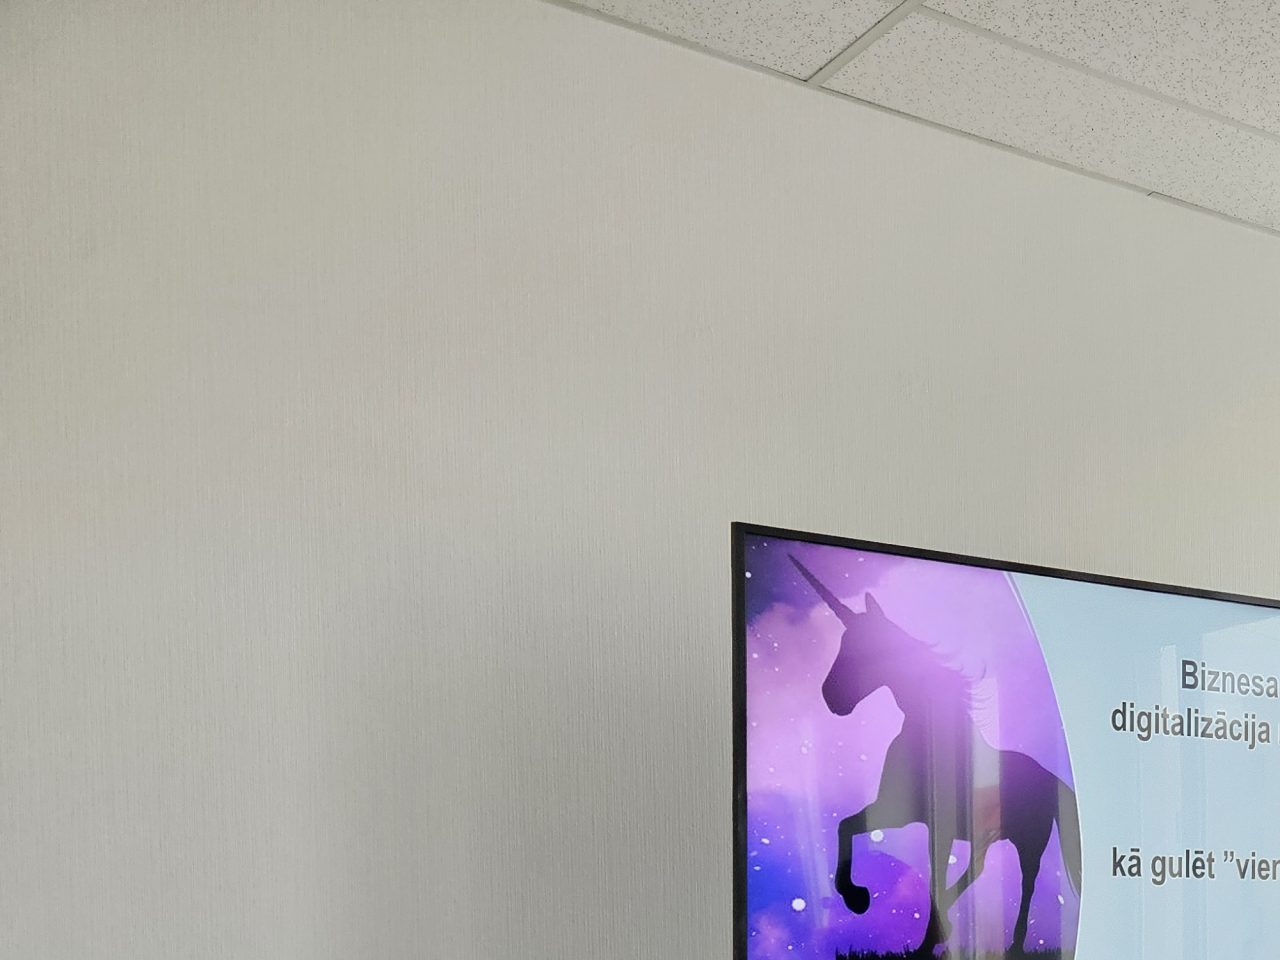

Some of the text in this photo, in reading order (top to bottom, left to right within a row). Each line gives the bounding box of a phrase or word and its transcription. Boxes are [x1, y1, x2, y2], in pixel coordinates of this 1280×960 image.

[1180, 659, 1279, 698] Biznesa
[1111, 702, 1271, 749] digitalizācija
[1111, 847, 1142, 877] kā
[1151, 850, 1215, 885] gulēt
